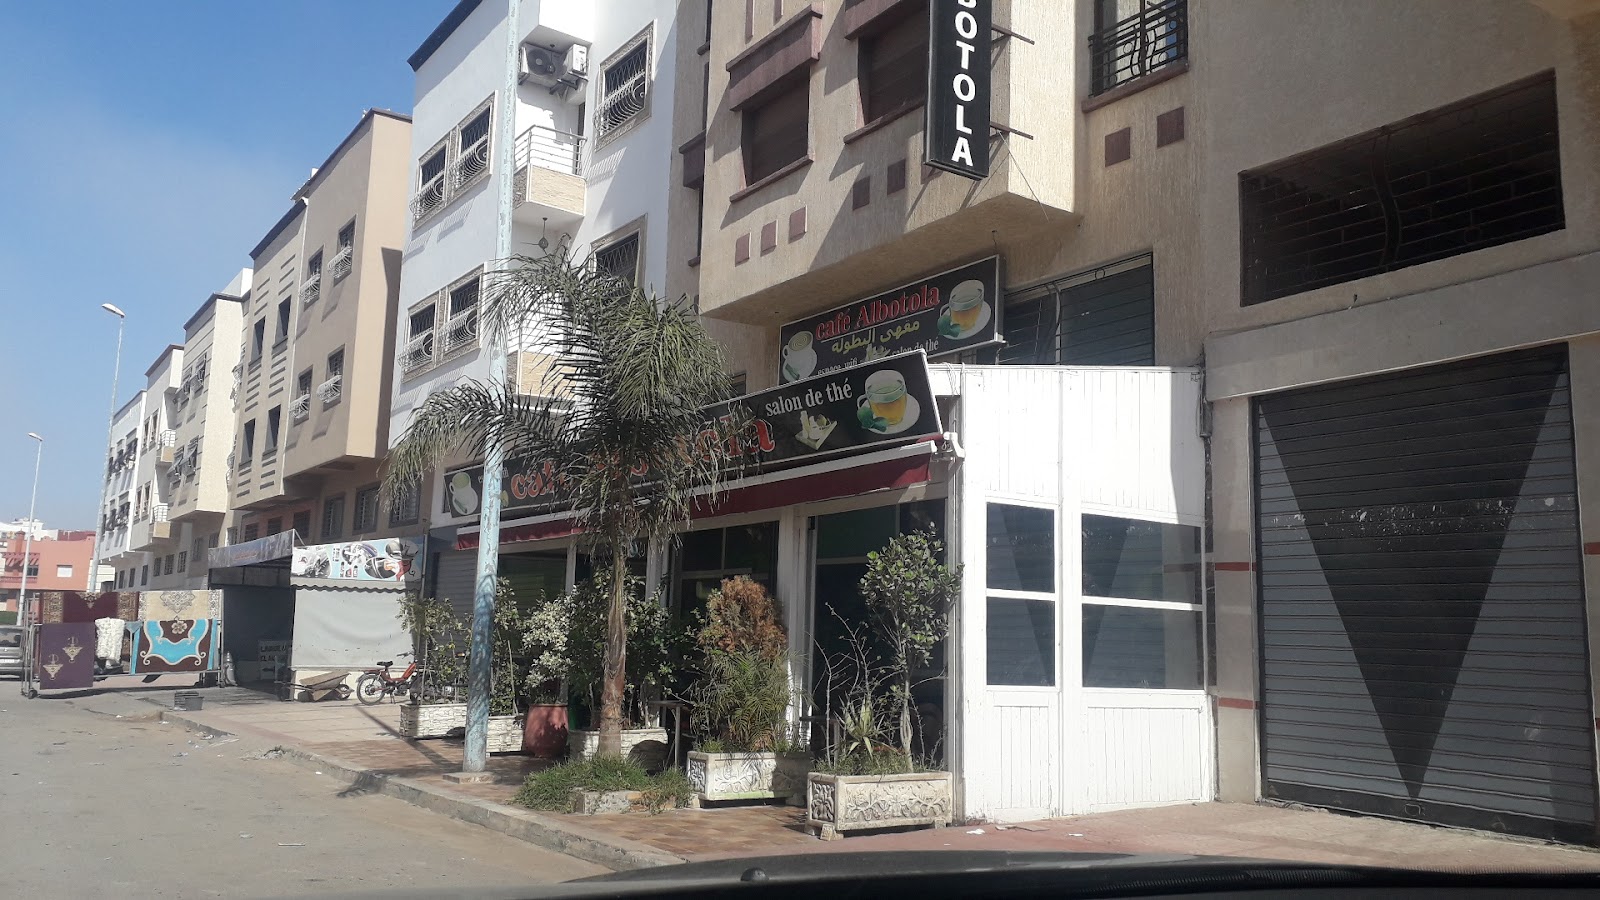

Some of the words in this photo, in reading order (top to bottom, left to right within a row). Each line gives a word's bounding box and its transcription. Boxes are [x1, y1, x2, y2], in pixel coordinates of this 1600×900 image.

[815, 307, 851, 340] café
[854, 284, 940, 330] Albotola
[831, 328, 877, 355] البطولة
[880, 320, 920, 343] مقهى
[925, 336, 939, 352] thé
[765, 395, 803, 417] salon
[805, 388, 823, 408] de
[825, 377, 853, 402] thé
